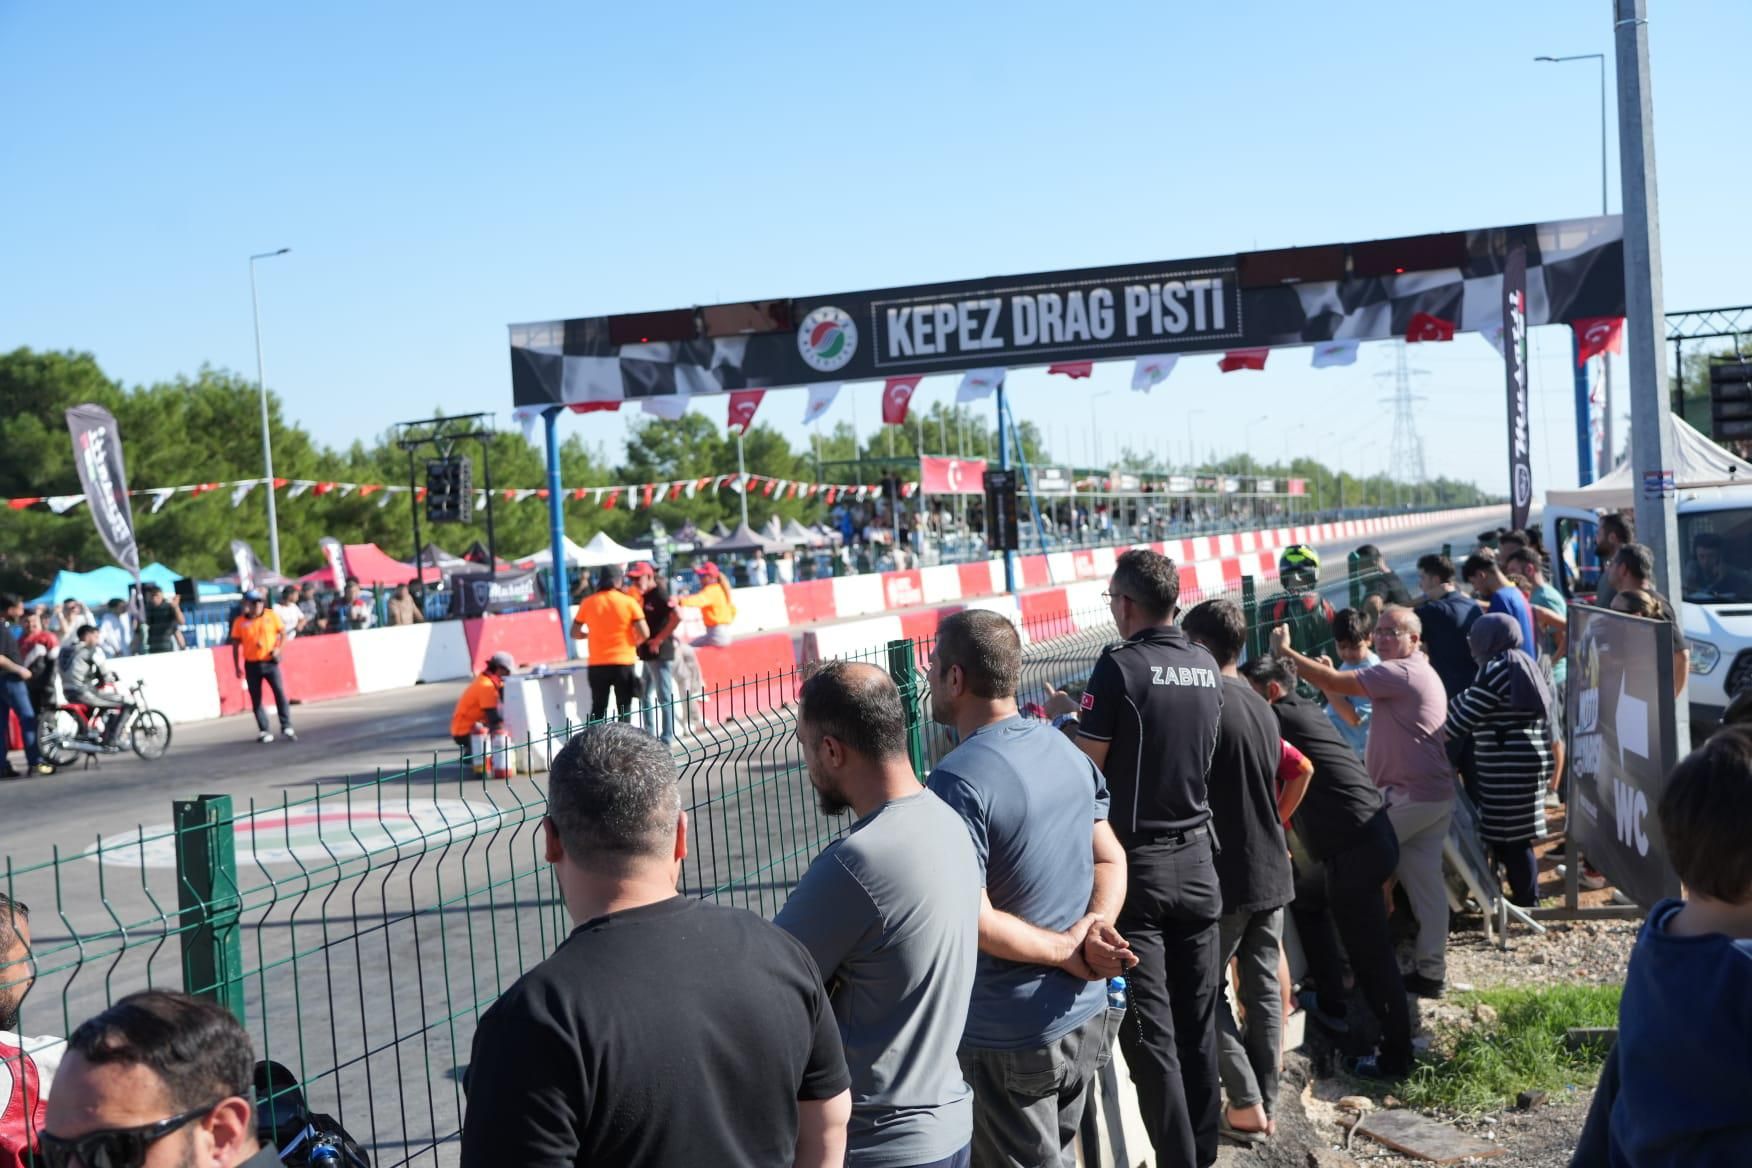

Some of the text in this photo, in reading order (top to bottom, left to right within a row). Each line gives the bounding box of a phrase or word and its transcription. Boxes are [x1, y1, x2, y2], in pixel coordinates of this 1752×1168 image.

[887, 298, 1003, 357] KEPEZ
[1012, 288, 1115, 347] DRAG
[1150, 666, 1216, 688] ZABITA
[1613, 777, 1649, 857] WC
